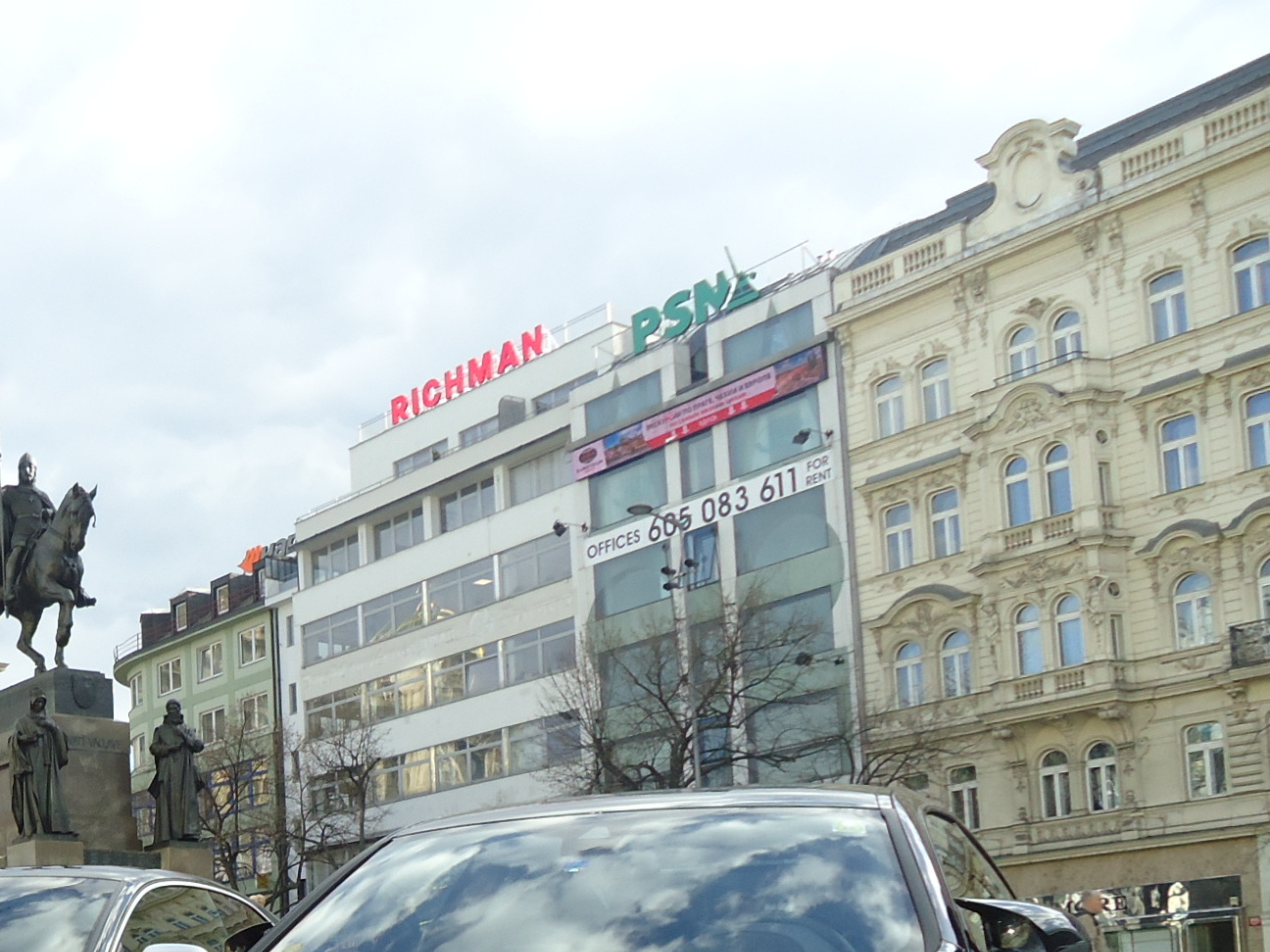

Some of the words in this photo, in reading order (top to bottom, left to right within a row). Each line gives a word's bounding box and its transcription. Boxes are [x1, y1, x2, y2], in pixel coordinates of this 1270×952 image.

[391, 324, 546, 425] RICHMAN
[806, 469, 832, 487] RENT
[807, 455, 829, 471] FOR
[587, 531, 641, 559] OFFICES
[648, 506, 692, 542] 605
[702, 486, 749, 523] 083
[760, 467, 798, 502] 611
